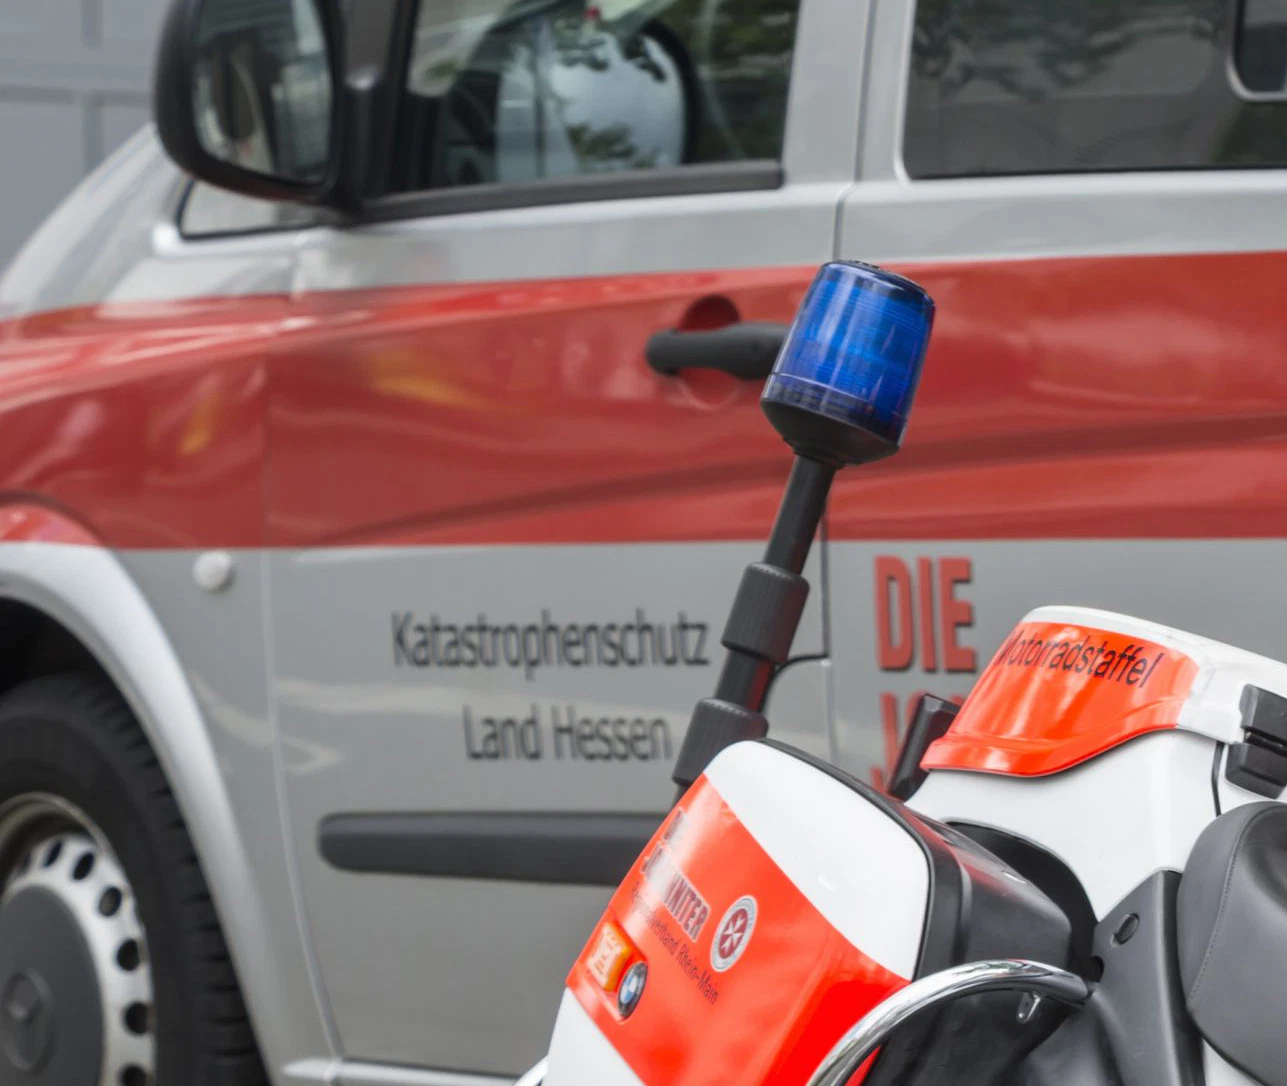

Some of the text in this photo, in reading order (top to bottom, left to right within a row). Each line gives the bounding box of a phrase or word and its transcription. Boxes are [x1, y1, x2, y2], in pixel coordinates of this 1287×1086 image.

[391, 607, 710, 682] Katastrophenschutz
[874, 555, 977, 673] DIE
[992, 630, 1165, 689] Motorradstaffel
[462, 702, 674, 761] Land Hessen
[676, 943, 720, 1006] Rhein-Main
